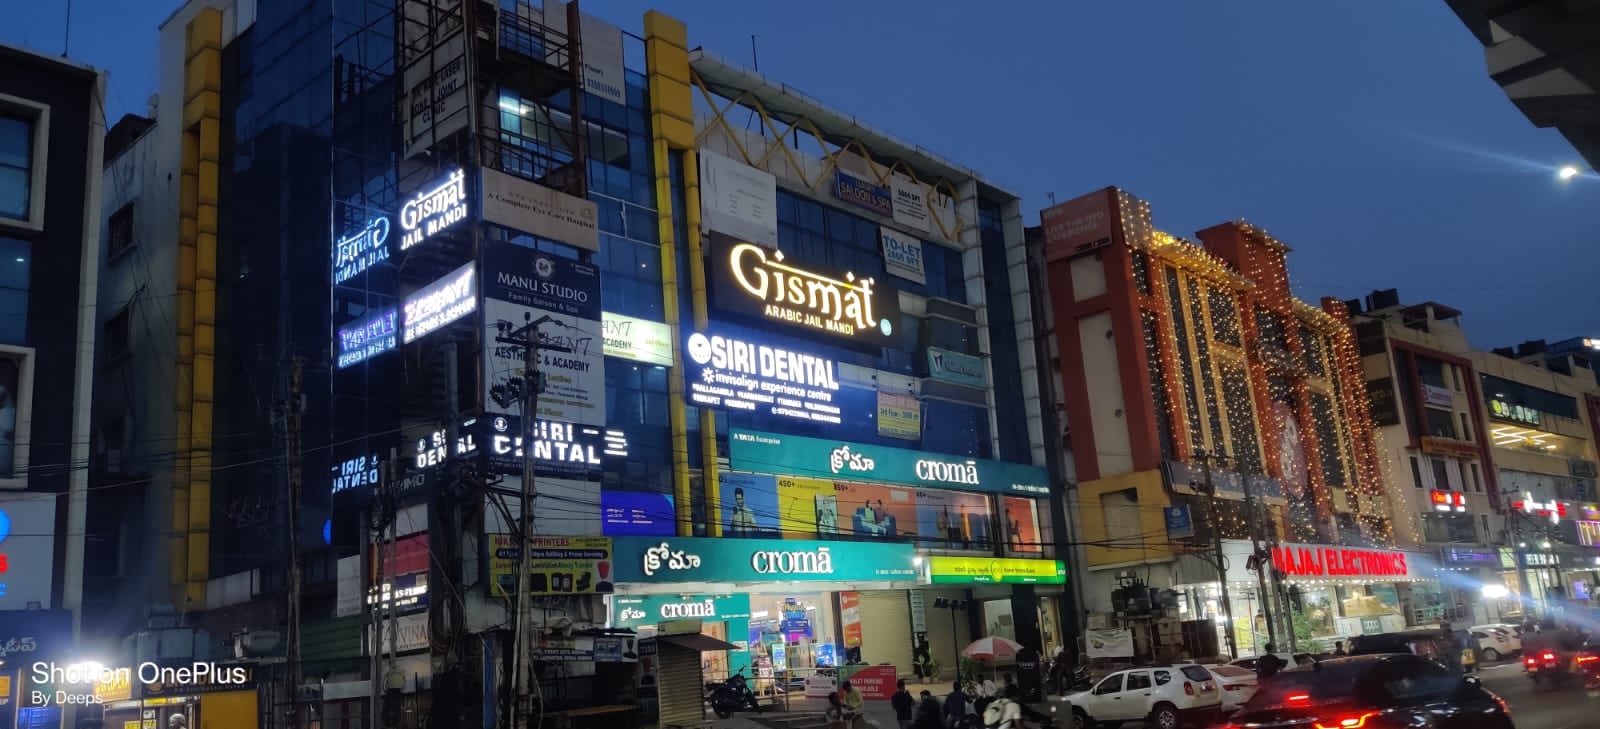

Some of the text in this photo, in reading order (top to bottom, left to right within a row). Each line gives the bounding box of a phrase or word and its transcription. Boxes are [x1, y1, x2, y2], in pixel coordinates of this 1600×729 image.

[401, 168, 466, 230] Gismat
[401, 204, 467, 251] JAIL MANDI
[497, 272, 588, 303] MANU STUDIO
[730, 243, 876, 329] Gismat
[765, 303, 854, 336] ARABIC JAIL MANDI
[544, 354, 550, 366] &
[552, 356, 590, 374] ACADEMY
[711, 335, 839, 391] SIRI DENTAL
[761, 381, 805, 398] experience
[417, 434, 476, 468] DENAL
[830, 445, 874, 473] క్రోమా
[643, 542, 701, 577] క్రోమా
[1325, 548, 1407, 577] ELECTRONICS
